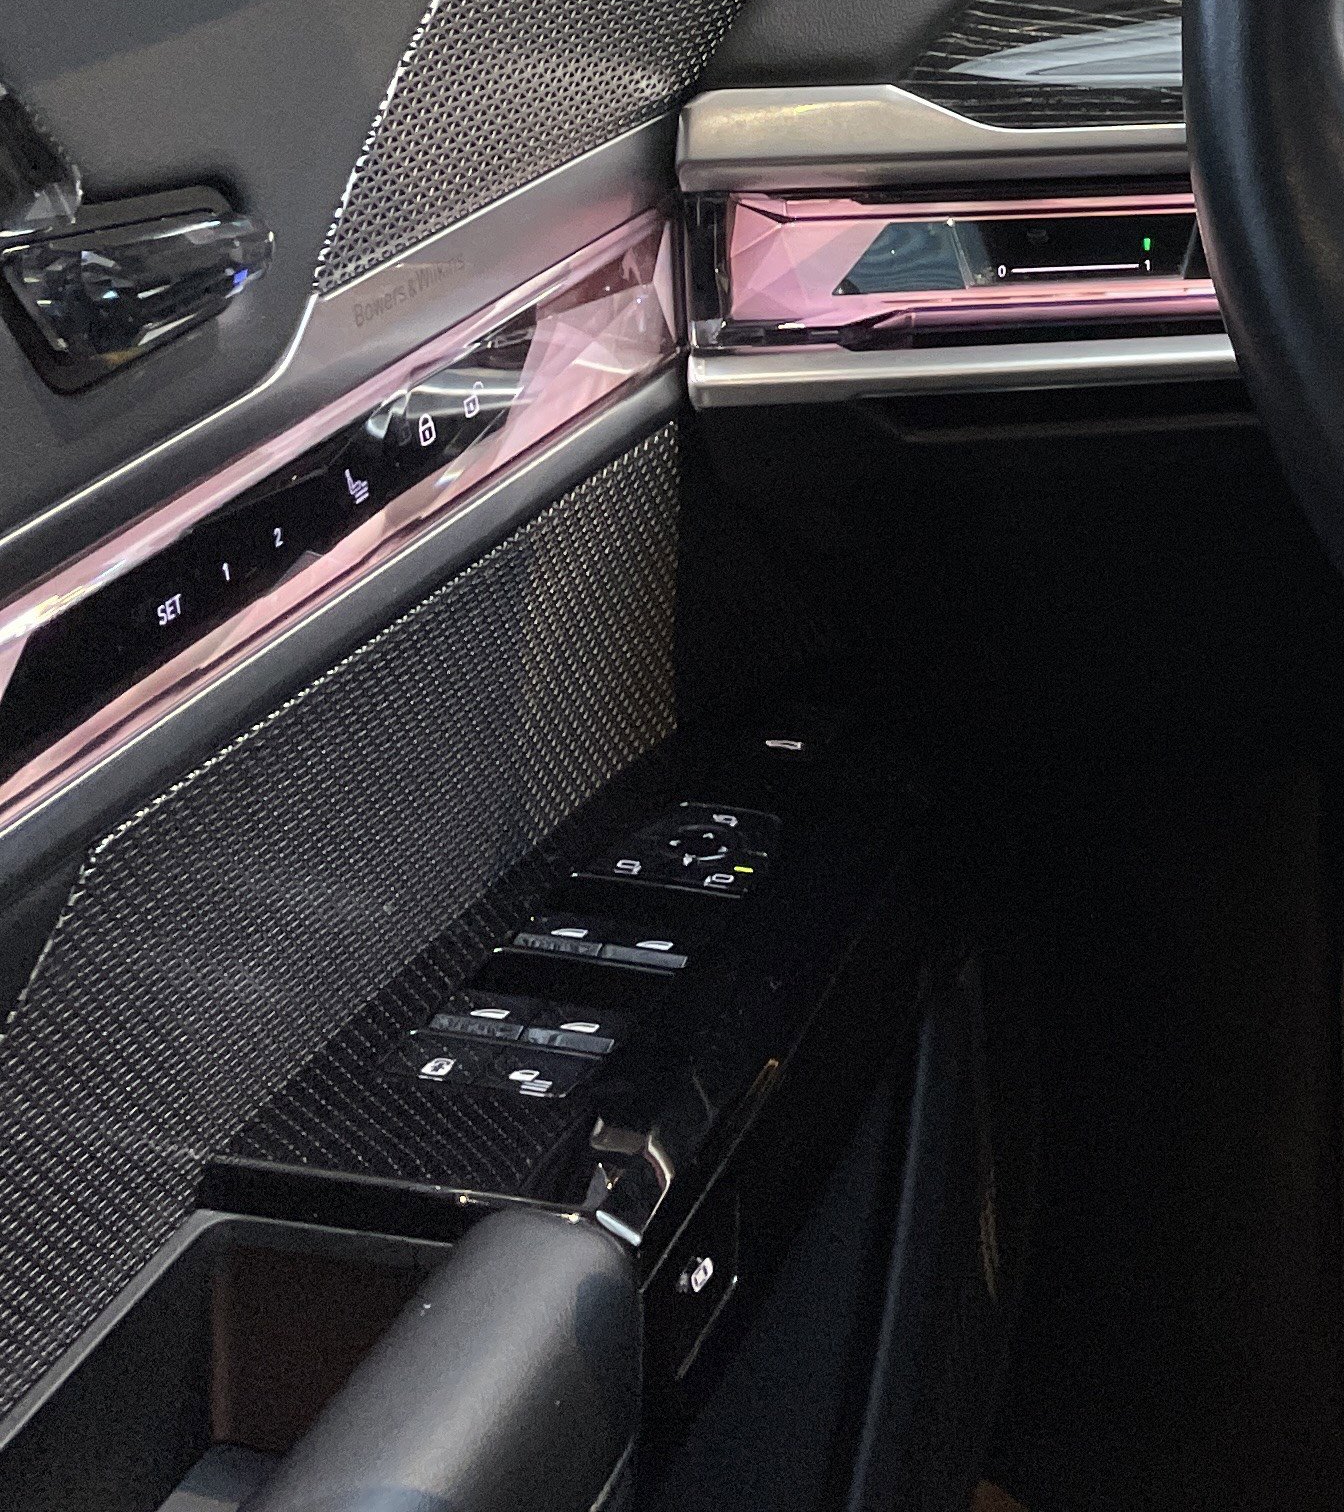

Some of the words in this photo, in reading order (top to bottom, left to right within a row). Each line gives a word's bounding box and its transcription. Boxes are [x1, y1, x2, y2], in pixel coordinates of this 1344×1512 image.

[997, 264, 1007, 278] 0
[1144, 259, 1151, 271] 1
[273, 527, 284, 548] 2
[222, 562, 231, 581] 1
[157, 593, 181, 626] SET
